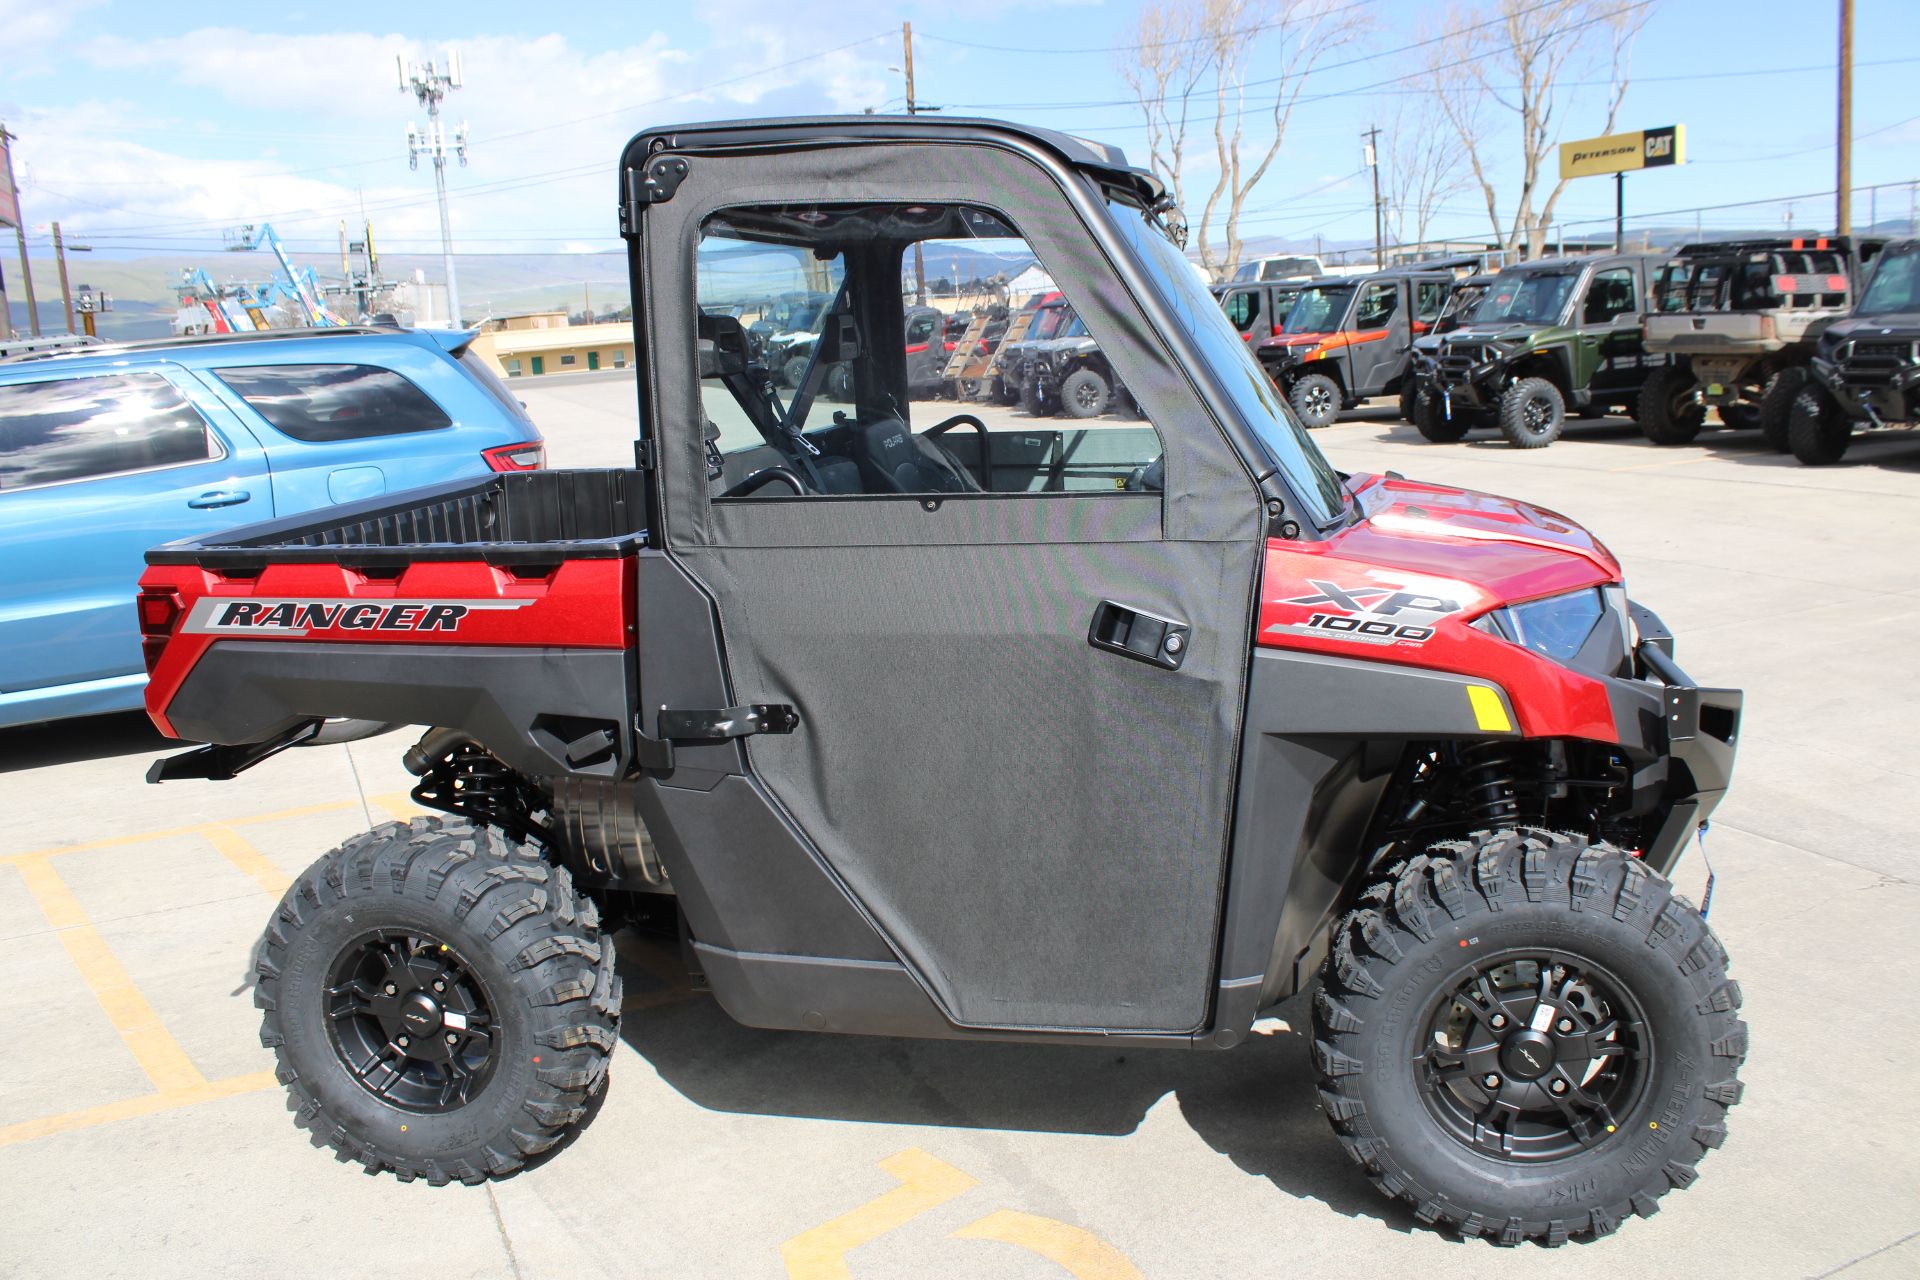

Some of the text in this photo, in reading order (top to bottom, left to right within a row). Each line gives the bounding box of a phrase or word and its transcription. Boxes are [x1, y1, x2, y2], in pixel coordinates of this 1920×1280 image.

[1571, 145, 1637, 165] PETERSON
[1645, 135, 1673, 158] CAT
[1272, 578, 1465, 617] XP
[217, 601, 469, 632] RANGER
[1307, 612, 1436, 642] 1000
[1303, 629, 1332, 637] DUAL
[1397, 640, 1424, 649] CAM
[1519, 1048, 1540, 1069] XP
[1620, 1049, 1698, 1178] X-TERRAIN
